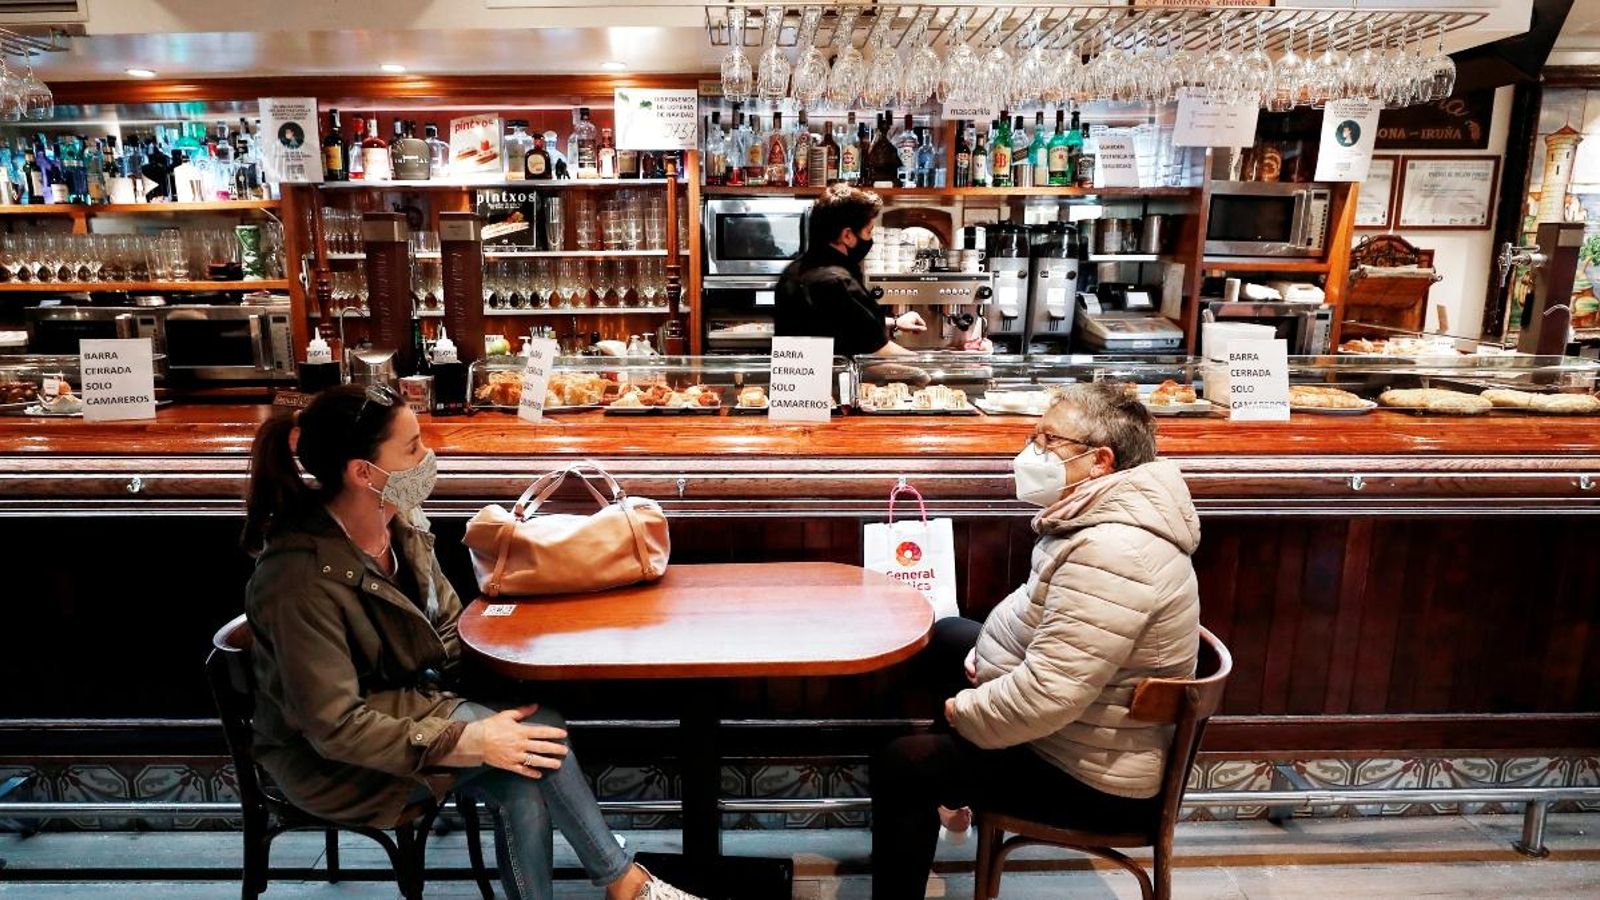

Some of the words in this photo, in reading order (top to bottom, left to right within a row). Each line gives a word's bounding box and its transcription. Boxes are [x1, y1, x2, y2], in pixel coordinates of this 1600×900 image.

[950, 107, 991, 116] mascarilla
[1420, 126, 1462, 140] IRUÑA
[477, 191, 536, 204] pintxos
[84, 351, 119, 360] BARRA
[773, 350, 804, 359] BARRA
[1229, 353, 1259, 361] BARRA
[85, 366, 132, 376] CERRADA
[772, 366, 815, 376] CERRADA
[1230, 369, 1271, 377] CERRADA
[85, 381, 112, 391] SOLO
[771, 383, 796, 392] SOLO
[1231, 385, 1255, 393] SOLO
[86, 395, 150, 405] CAMAREROS
[771, 399, 829, 409] CAMAREROS
[886, 568, 935, 580] General
